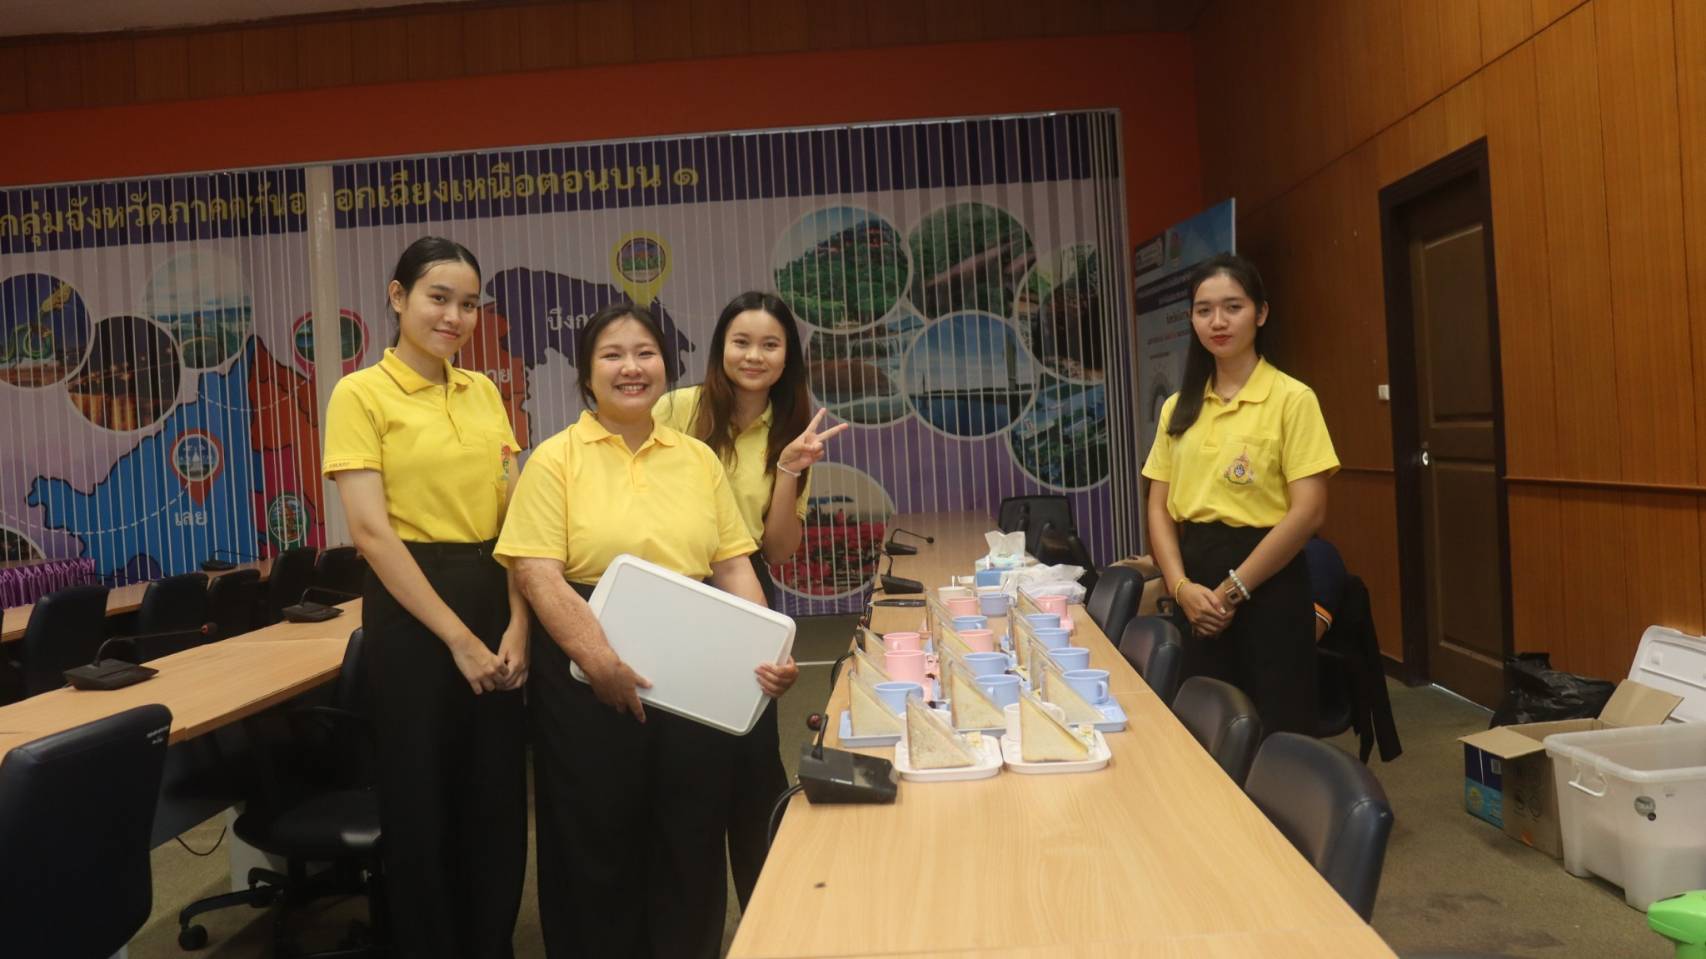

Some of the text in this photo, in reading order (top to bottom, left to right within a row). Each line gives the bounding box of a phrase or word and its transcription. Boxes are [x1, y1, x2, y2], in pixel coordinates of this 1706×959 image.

[673, 167, 700, 187] ๑
[547, 306, 595, 331] บึงก
[174, 511, 208, 527] เลย
